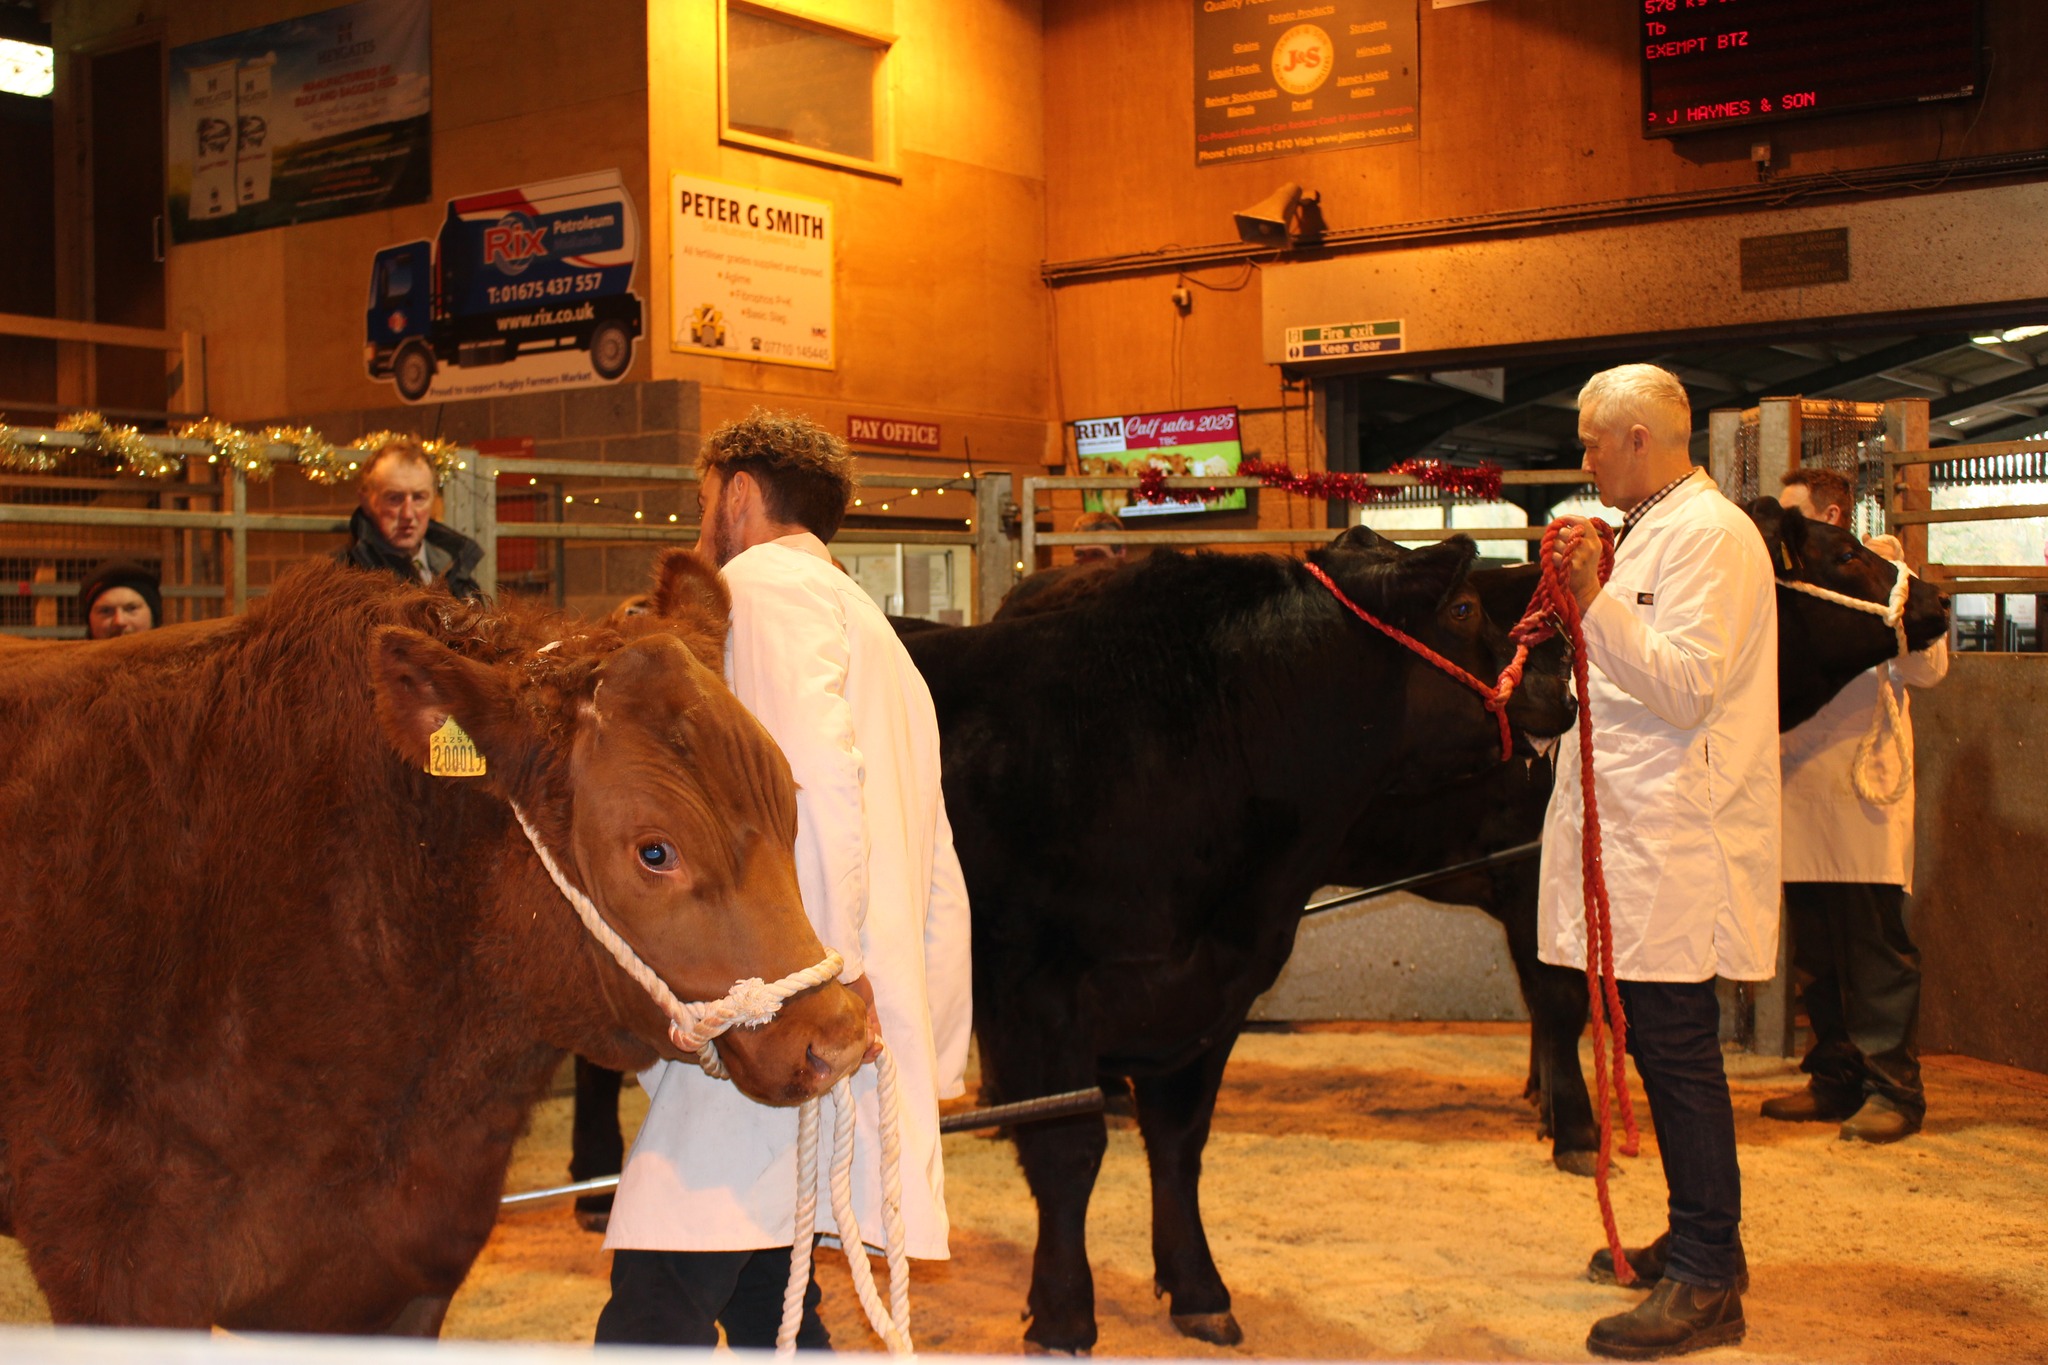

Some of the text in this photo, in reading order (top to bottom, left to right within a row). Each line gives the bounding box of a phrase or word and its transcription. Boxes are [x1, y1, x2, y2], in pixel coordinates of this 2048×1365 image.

[1297, 5, 1335, 20] Products
[1645, 0, 1677, 14] 578
[1349, 20, 1388, 36] Straights
[1645, 22, 1667, 37] Tb
[1233, 41, 1261, 55] Grains
[1356, 43, 1393, 58] Minerals
[1646, 31, 1749, 60] EXEMPT BTZ
[1283, 46, 1321, 73] J&S
[1207, 63, 1263, 80] Liquid Feeds
[1365, 70, 1389, 83] Moist
[1666, 109, 1679, 125] J
[1687, 100, 1752, 122] HAYNES
[1760, 97, 1772, 113] &
[1782, 91, 1817, 110] SON
[1198, 129, 1240, 143] Co-Product
[1241, 125, 1272, 138] Feeding
[1273, 122, 1288, 132] Can
[1288, 118, 1318, 130] Reduce
[1319, 116, 1337, 126] Cost
[1347, 109, 1382, 121] Increase
[1199, 148, 1226, 161] Phone
[1226, 144, 1255, 157] 01933
[1275, 139, 1293, 151] 470
[1294, 137, 1316, 148] Visit
[1316, 122, 1414, 145] www.james-son.co.uk
[553, 212, 615, 235] Petroleum
[681, 190, 825, 241] PETER G SMITH
[484, 223, 549, 265] Rix
[726, 253, 752, 267] grades
[754, 257, 783, 271] supplied
[785, 262, 798, 273] and
[547, 276, 573, 296] 437
[575, 272, 603, 292] 557
[497, 302, 595, 332] www.rix.co.uk
[1320, 324, 1375, 341] Fire exit
[765, 340, 793, 357] 07710
[1320, 341, 1382, 355] Keep clear
[430, 370, 593, 398] Proud to support Rugby Farmers Market
[851, 418, 938, 445] PAY OFFICE
[1076, 413, 1236, 440] RFM Calf sales 2025
[1158, 436, 1178, 446] TBC
